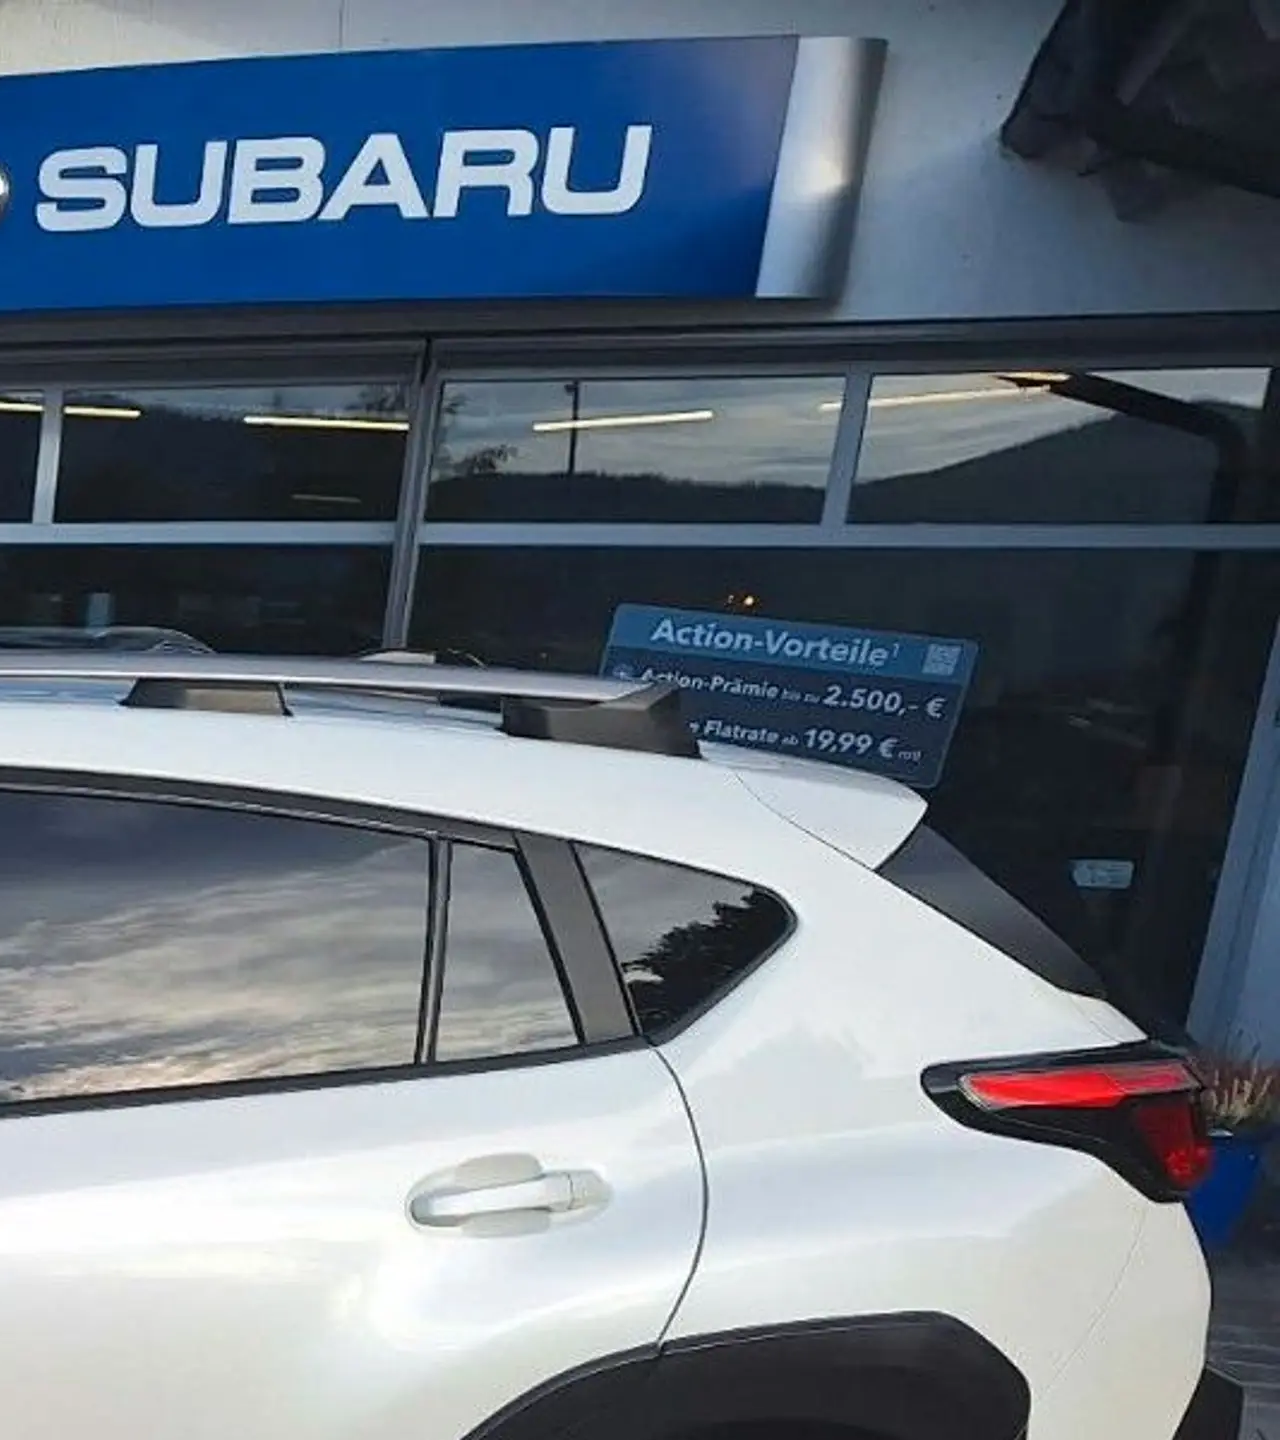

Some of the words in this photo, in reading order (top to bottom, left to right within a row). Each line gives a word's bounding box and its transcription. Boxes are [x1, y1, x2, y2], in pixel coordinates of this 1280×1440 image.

[35, 125, 652, 234] SUBARU
[926, 697, 947, 718] €
[703, 719, 780, 744] Flatrate
[804, 728, 873, 754] 19,99
[878, 738, 899, 758] €
